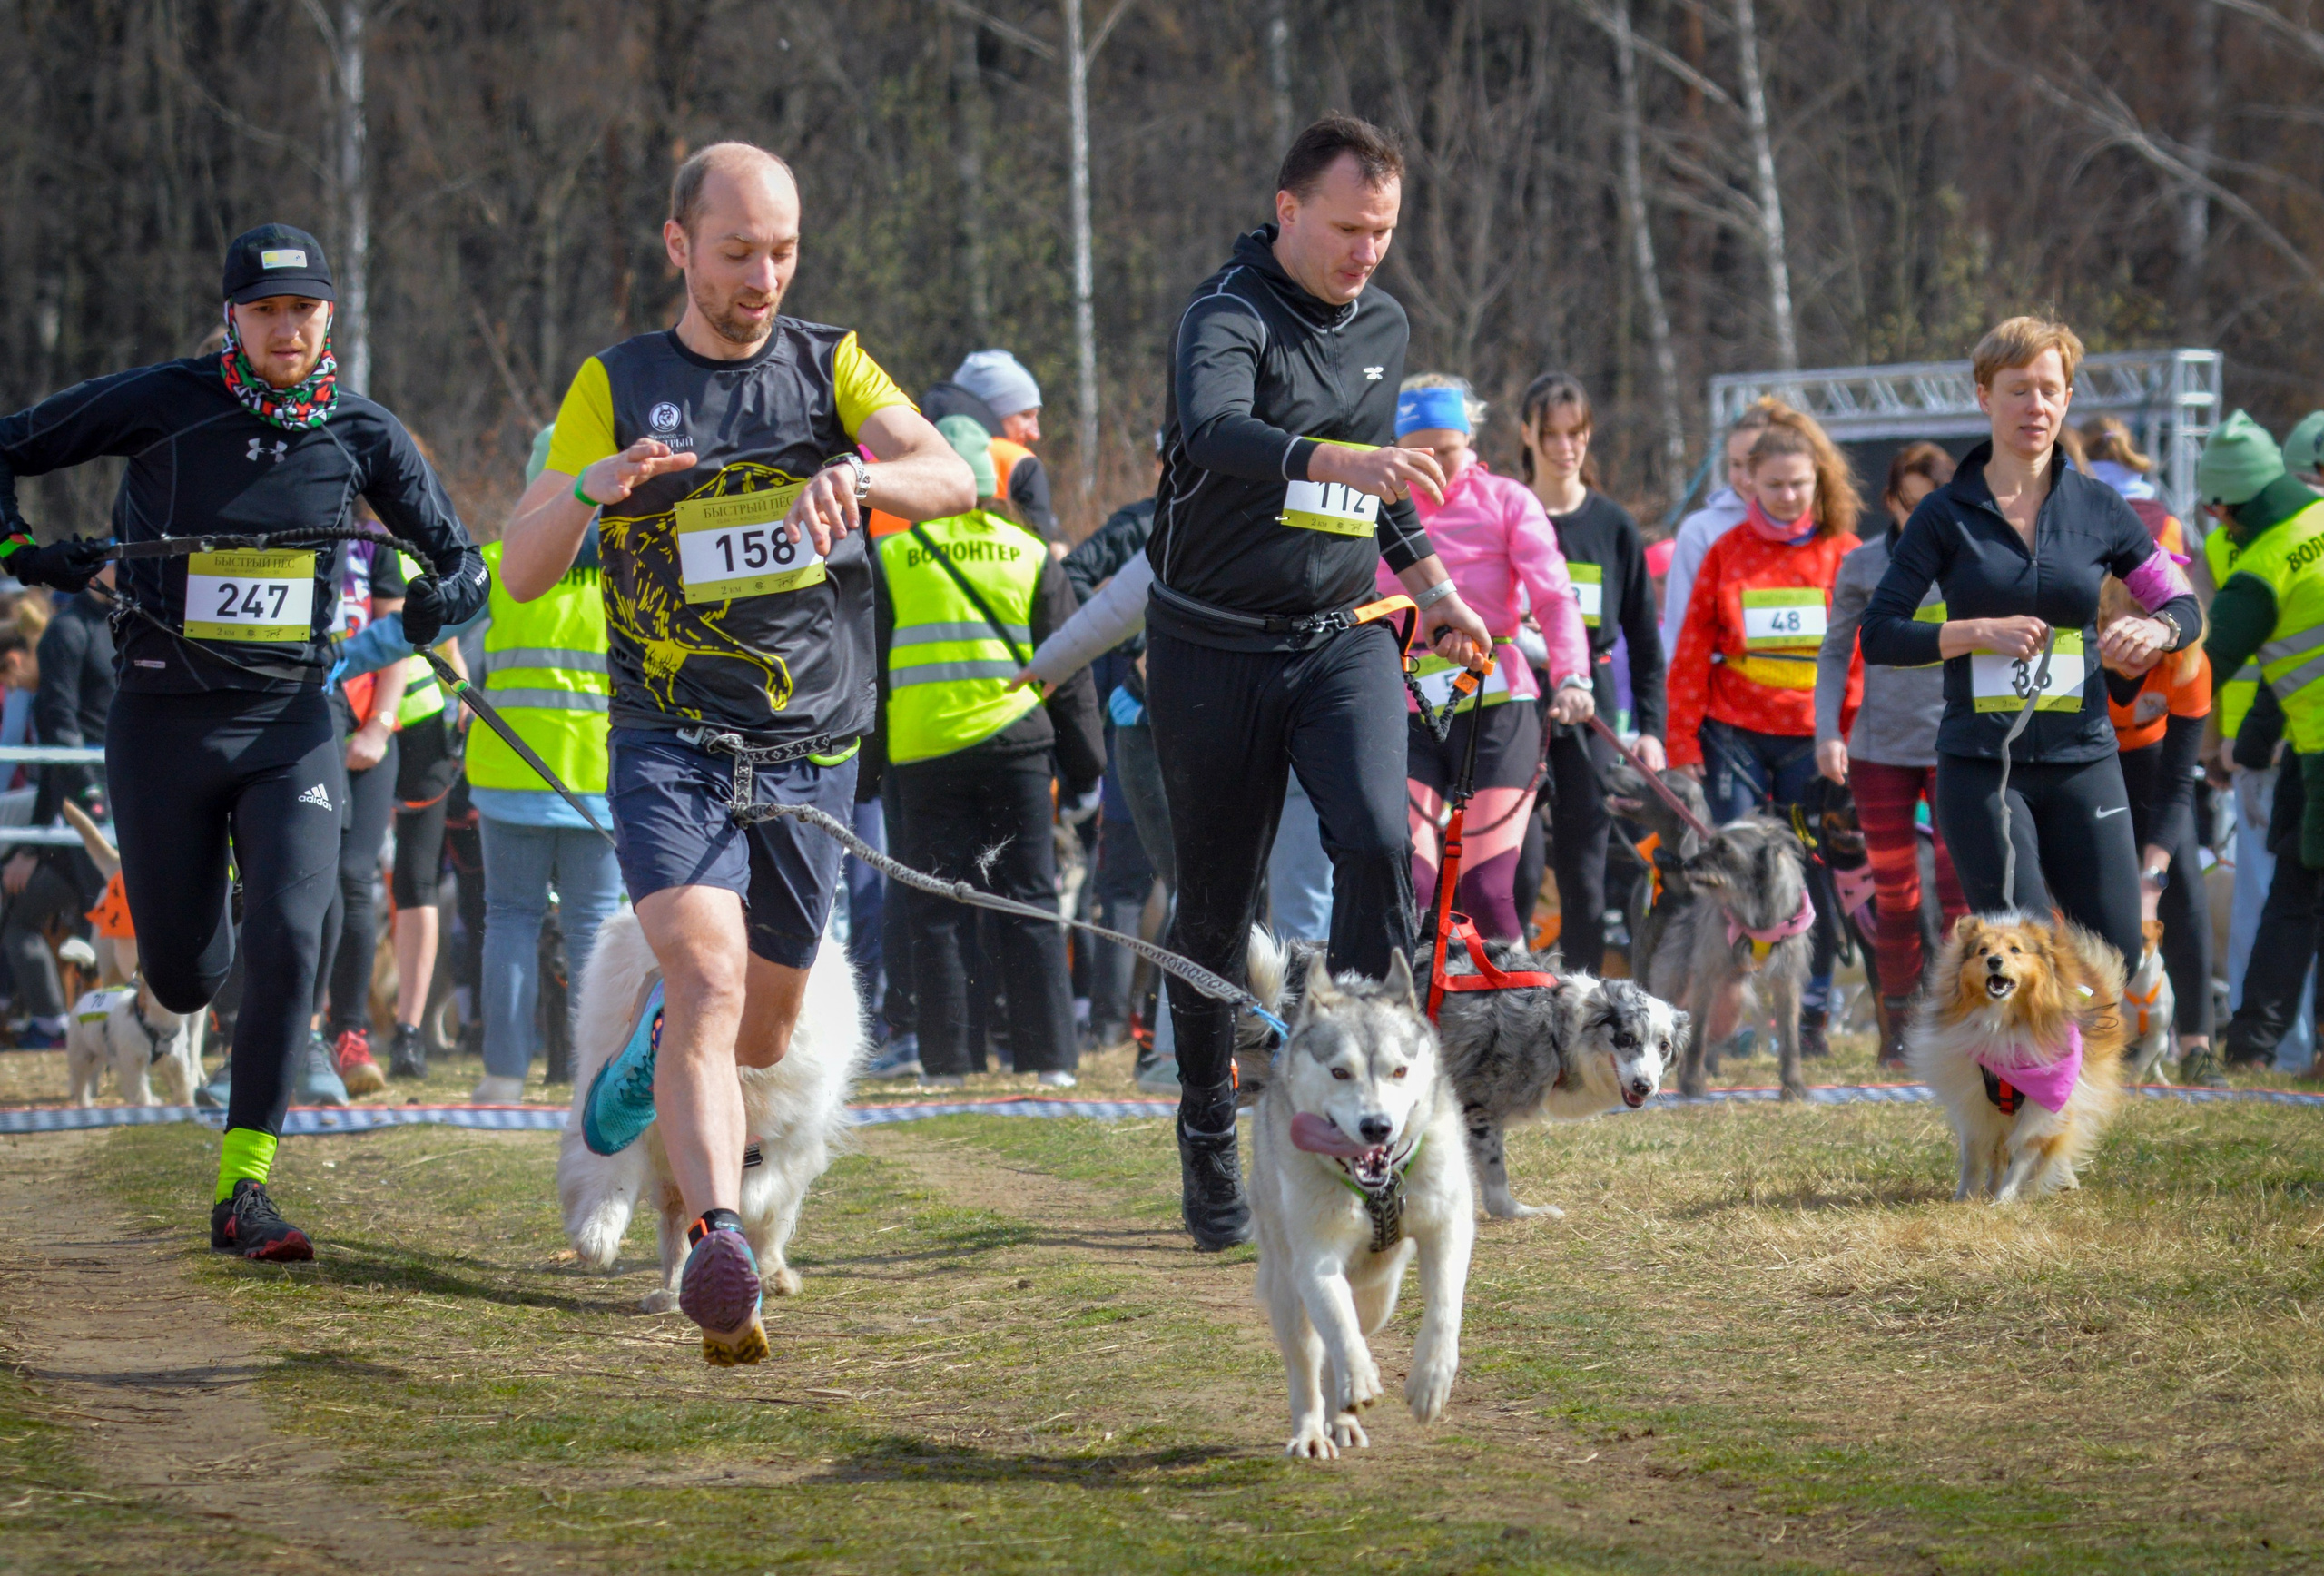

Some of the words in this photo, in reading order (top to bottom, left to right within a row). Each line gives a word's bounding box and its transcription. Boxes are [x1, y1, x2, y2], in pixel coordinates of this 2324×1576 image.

[704, 500, 767, 518] БЫСТРЫЙ
[771, 495, 793, 509] ПЁС
[715, 527, 796, 572] 158
[2286, 532, 2324, 573] ВОЛ
[214, 556, 271, 568] БЫСТРЫЙ
[272, 557, 295, 569] ПЁС
[217, 583, 289, 618] 247
[721, 586, 727, 595] 2
[1771, 611, 1800, 631] 48
[298, 795, 333, 812] adidas
[91, 993, 107, 1009] 70
